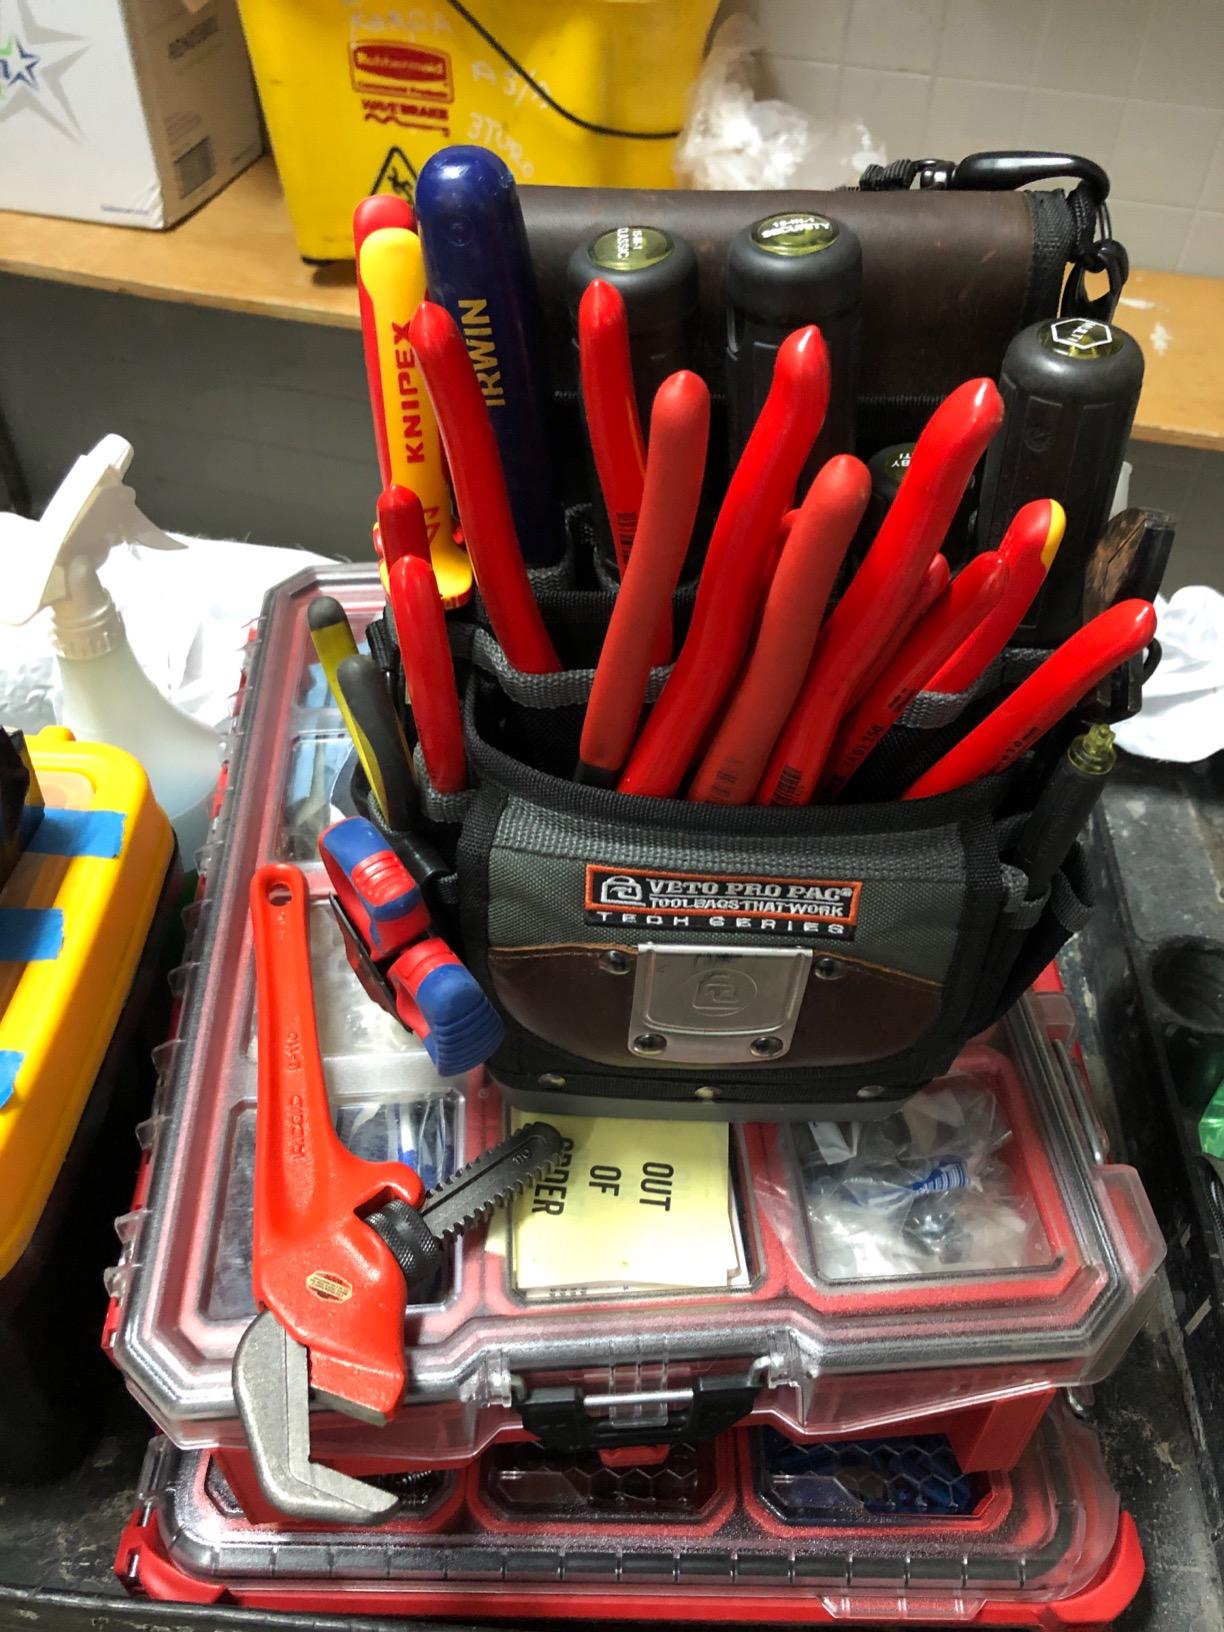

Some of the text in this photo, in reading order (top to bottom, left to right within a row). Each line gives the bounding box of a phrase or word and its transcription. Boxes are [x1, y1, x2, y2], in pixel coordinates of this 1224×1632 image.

[760, 220, 831, 240] SECURITY
[457, 298, 506, 408] IRWIN
[391, 319, 425, 465] KNIPEX
[646, 877, 718, 896] VETO
[725, 882, 782, 898] PRO
[596, 911, 845, 935] TECH SERIES
[786, 902, 844, 917] WORK
[588, 1164, 622, 1197] OF
[639, 1161, 675, 1212] OUT
